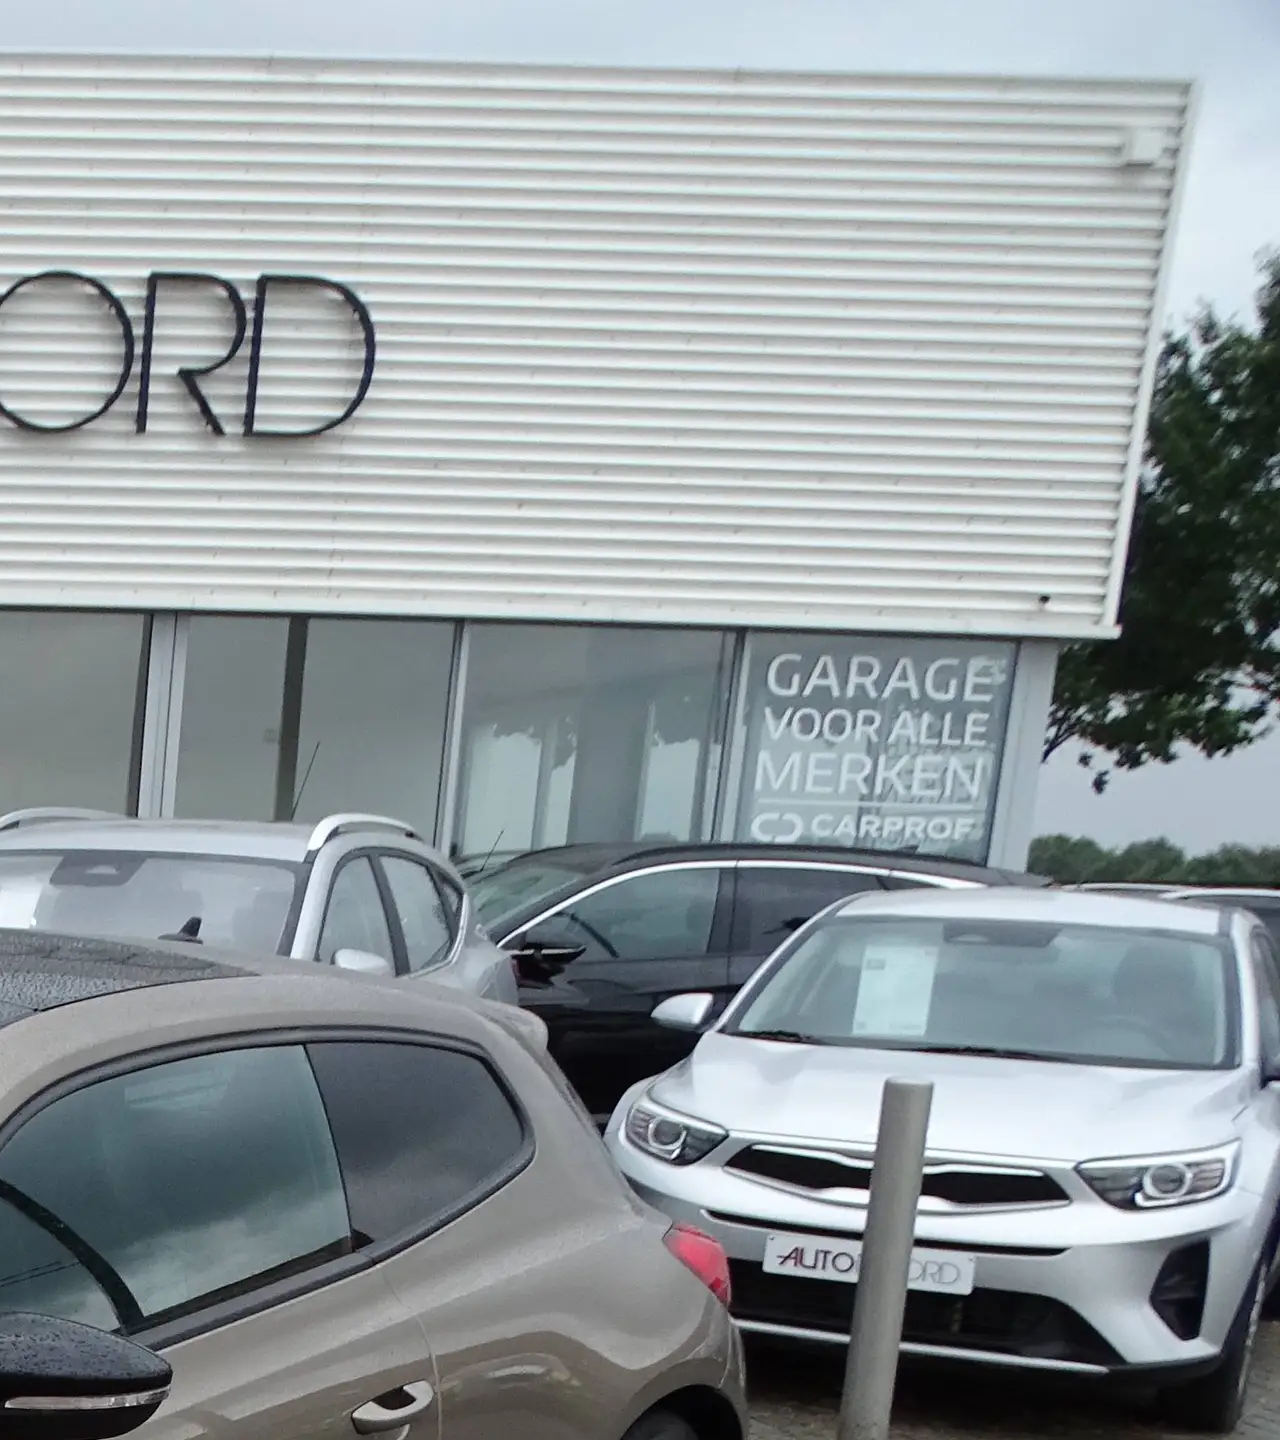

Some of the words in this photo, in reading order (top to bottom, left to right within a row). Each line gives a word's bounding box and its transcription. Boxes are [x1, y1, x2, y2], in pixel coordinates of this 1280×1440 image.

[766, 653, 996, 703] GARAGE
[764, 706, 882, 743] VOOR
[887, 709, 991, 747] ALLE
[754, 750, 986, 800] MERKEN
[811, 813, 976, 840] CARPROF
